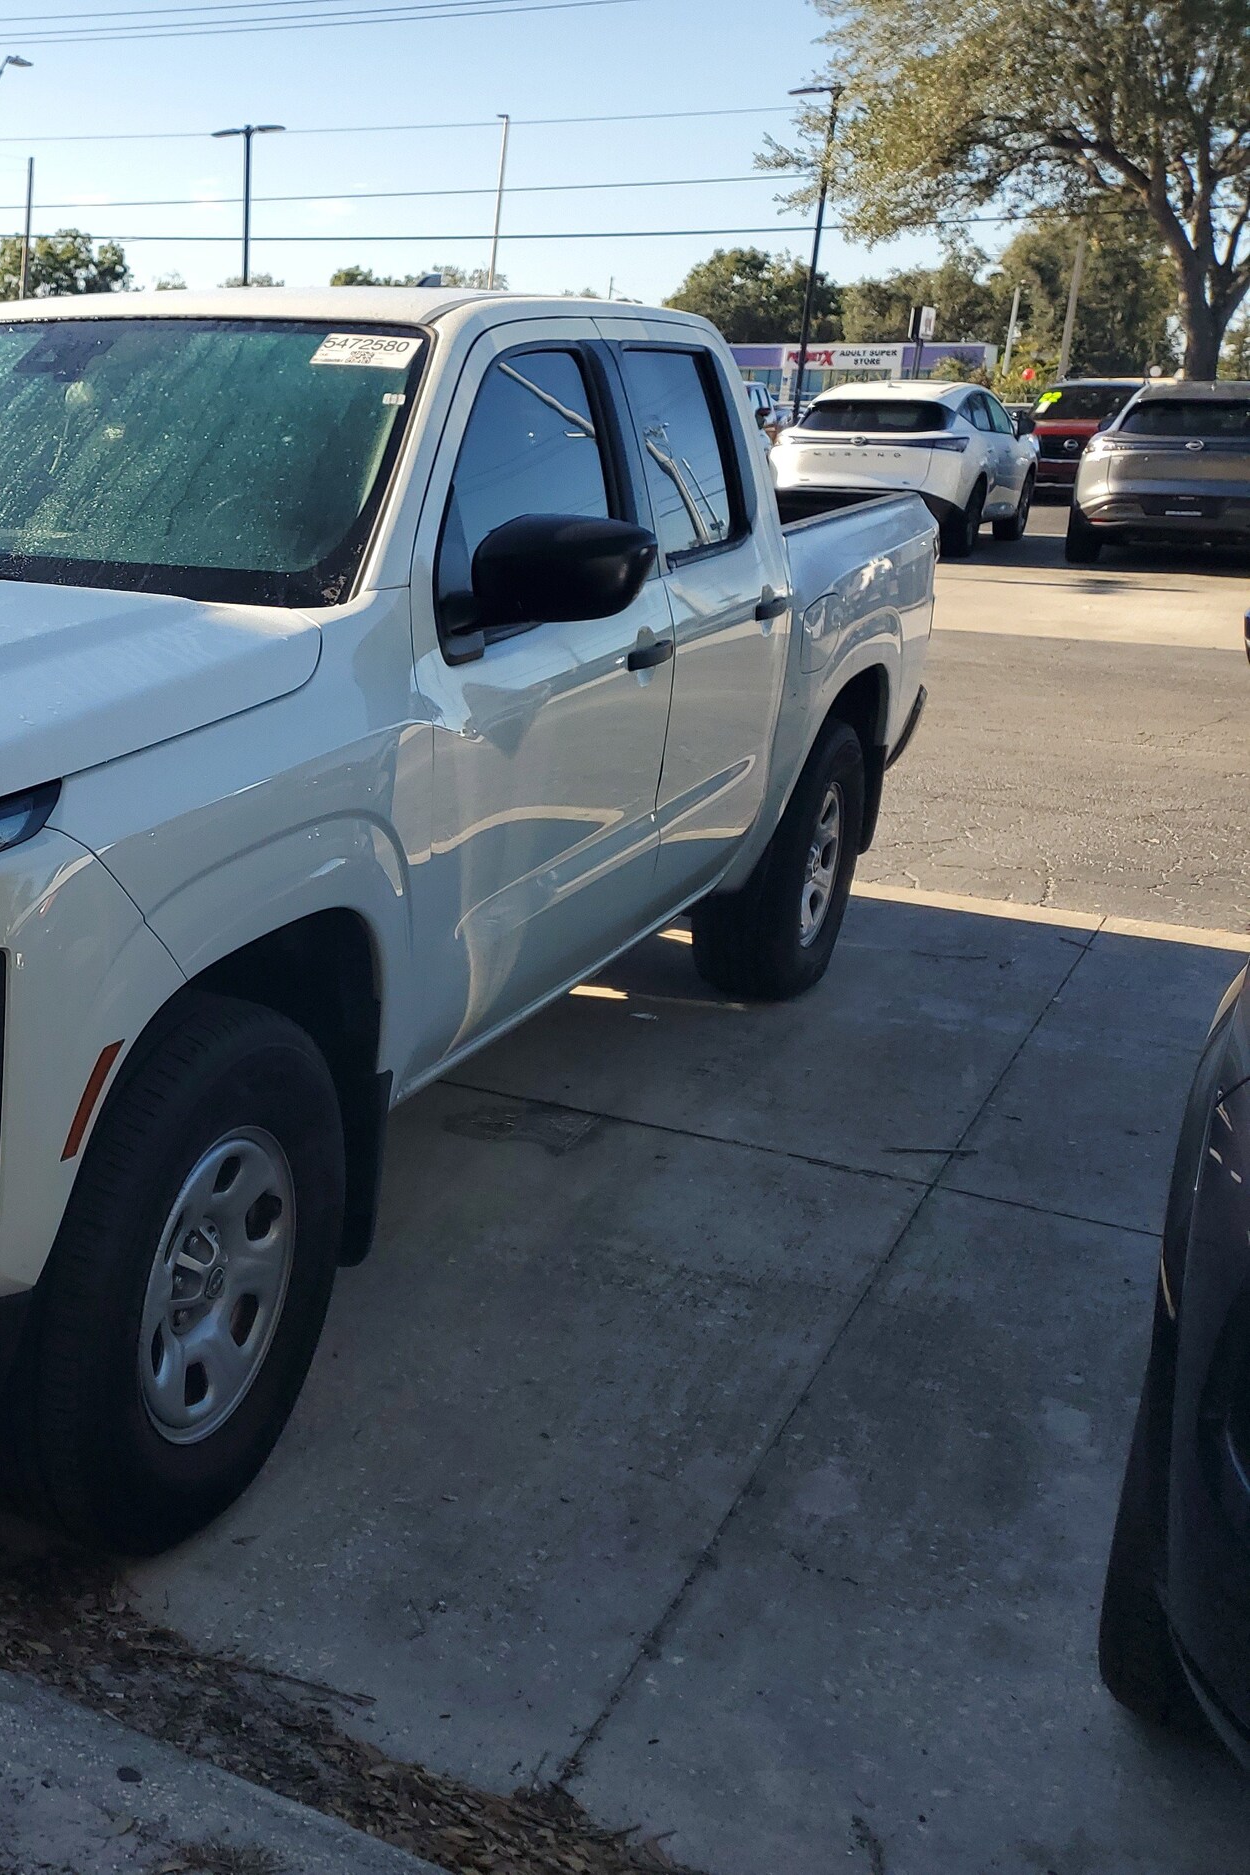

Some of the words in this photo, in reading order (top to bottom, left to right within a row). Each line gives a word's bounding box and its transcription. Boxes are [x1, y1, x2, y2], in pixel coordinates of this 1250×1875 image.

[323, 337, 410, 353] 5472580
[839, 349, 867, 357] ADULT
[853, 357, 881, 366] STORE
